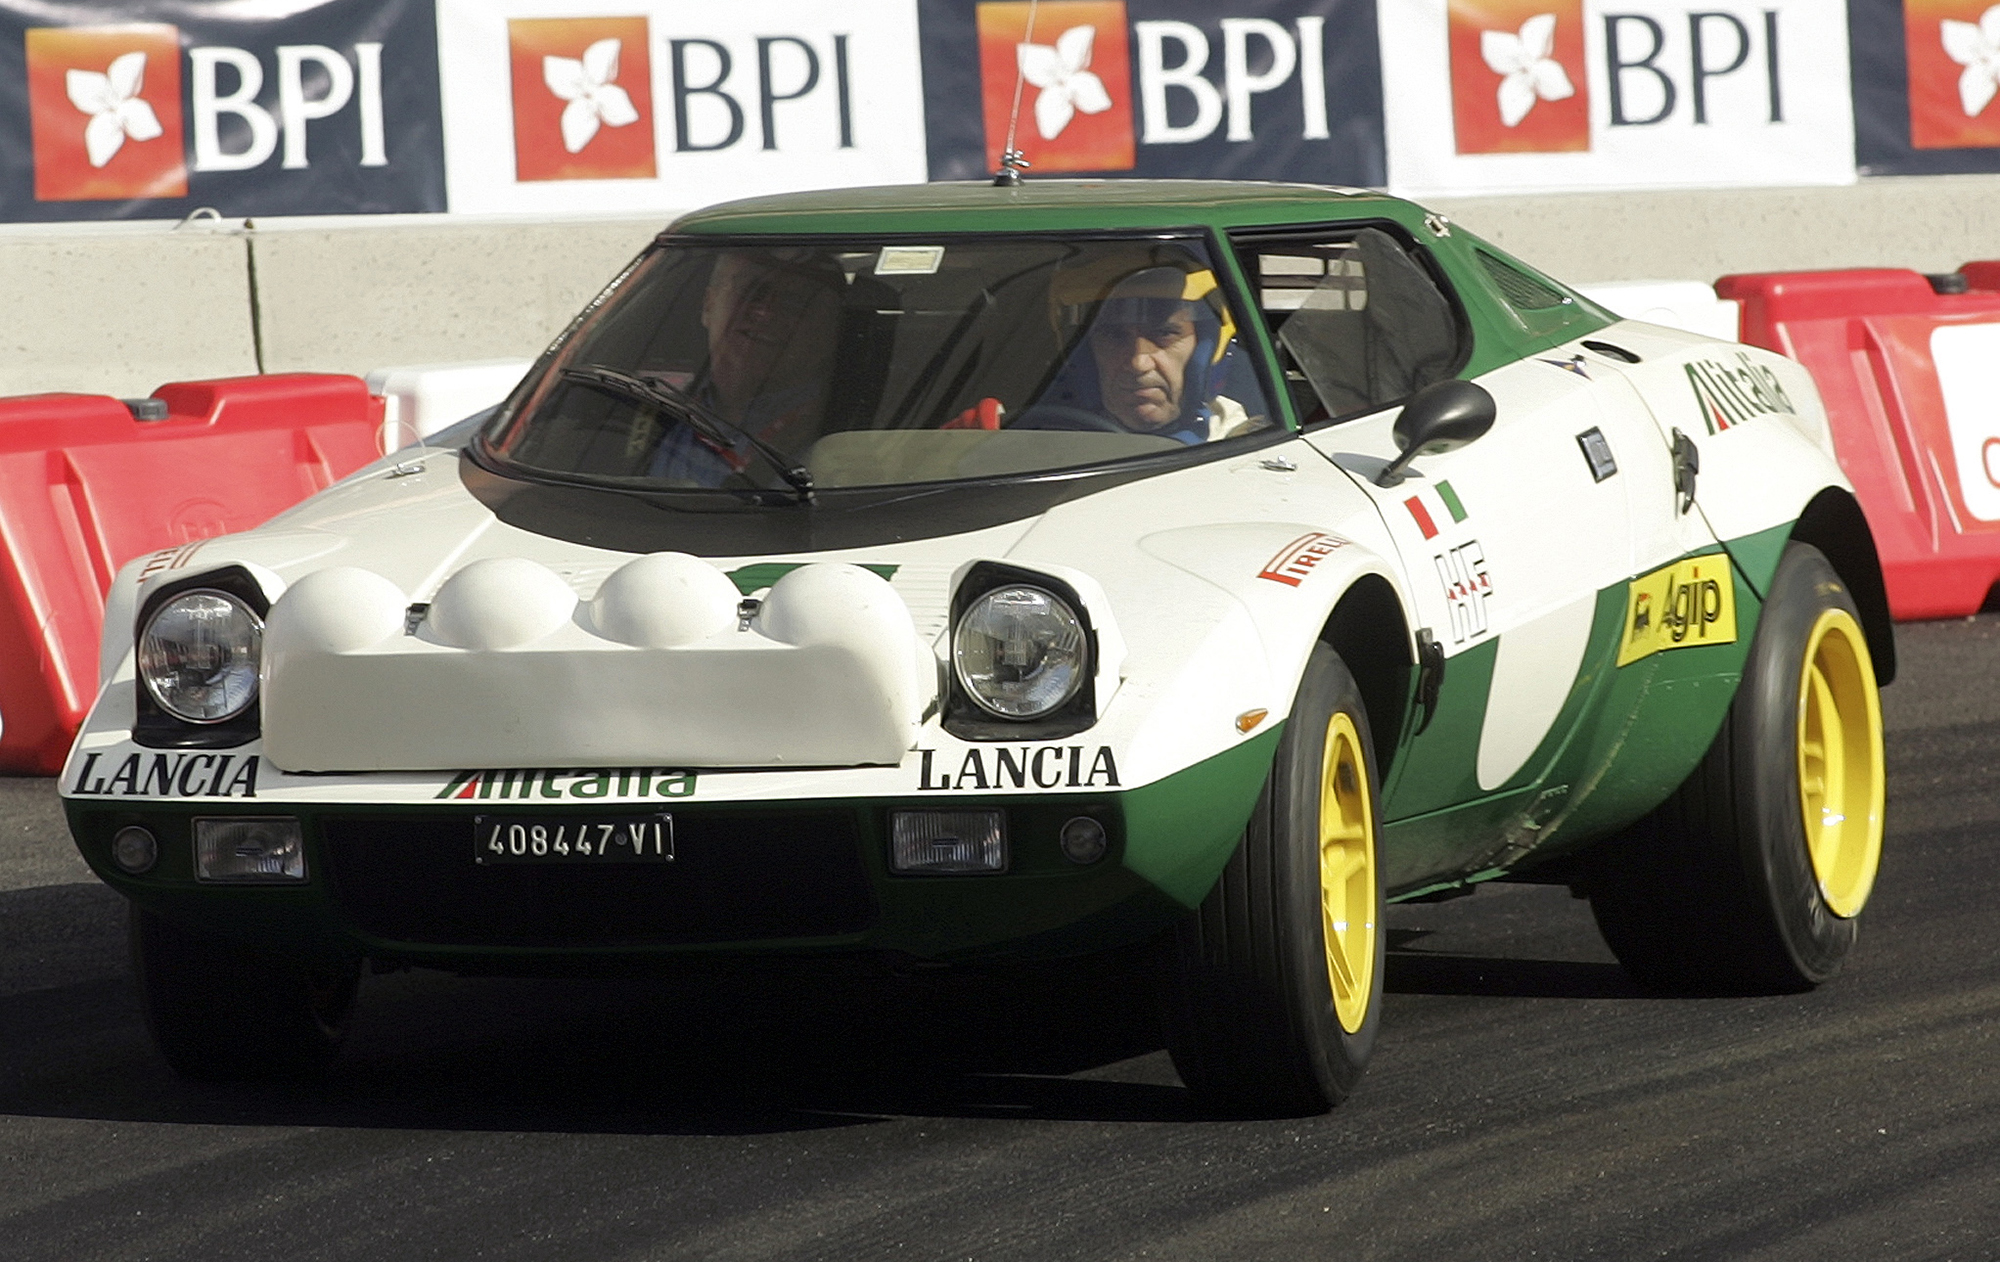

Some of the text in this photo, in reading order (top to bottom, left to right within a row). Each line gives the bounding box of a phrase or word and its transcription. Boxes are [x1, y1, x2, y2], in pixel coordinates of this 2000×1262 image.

[189, 43, 389, 172] BPI
[670, 34, 859, 152] BPI
[1135, 16, 1331, 144] BPI
[1603, 9, 1786, 126] BPI
[1683, 351, 1796, 436] Alitalia
[1256, 532, 1353, 588] PIRELLI
[1433, 540, 1494, 645] HF
[1656, 566, 1721, 642] Agip
[71, 752, 261, 798] LANCIA
[908, 745, 1122, 791] LANCIA
[487, 823, 663, 856] 408447 VI
